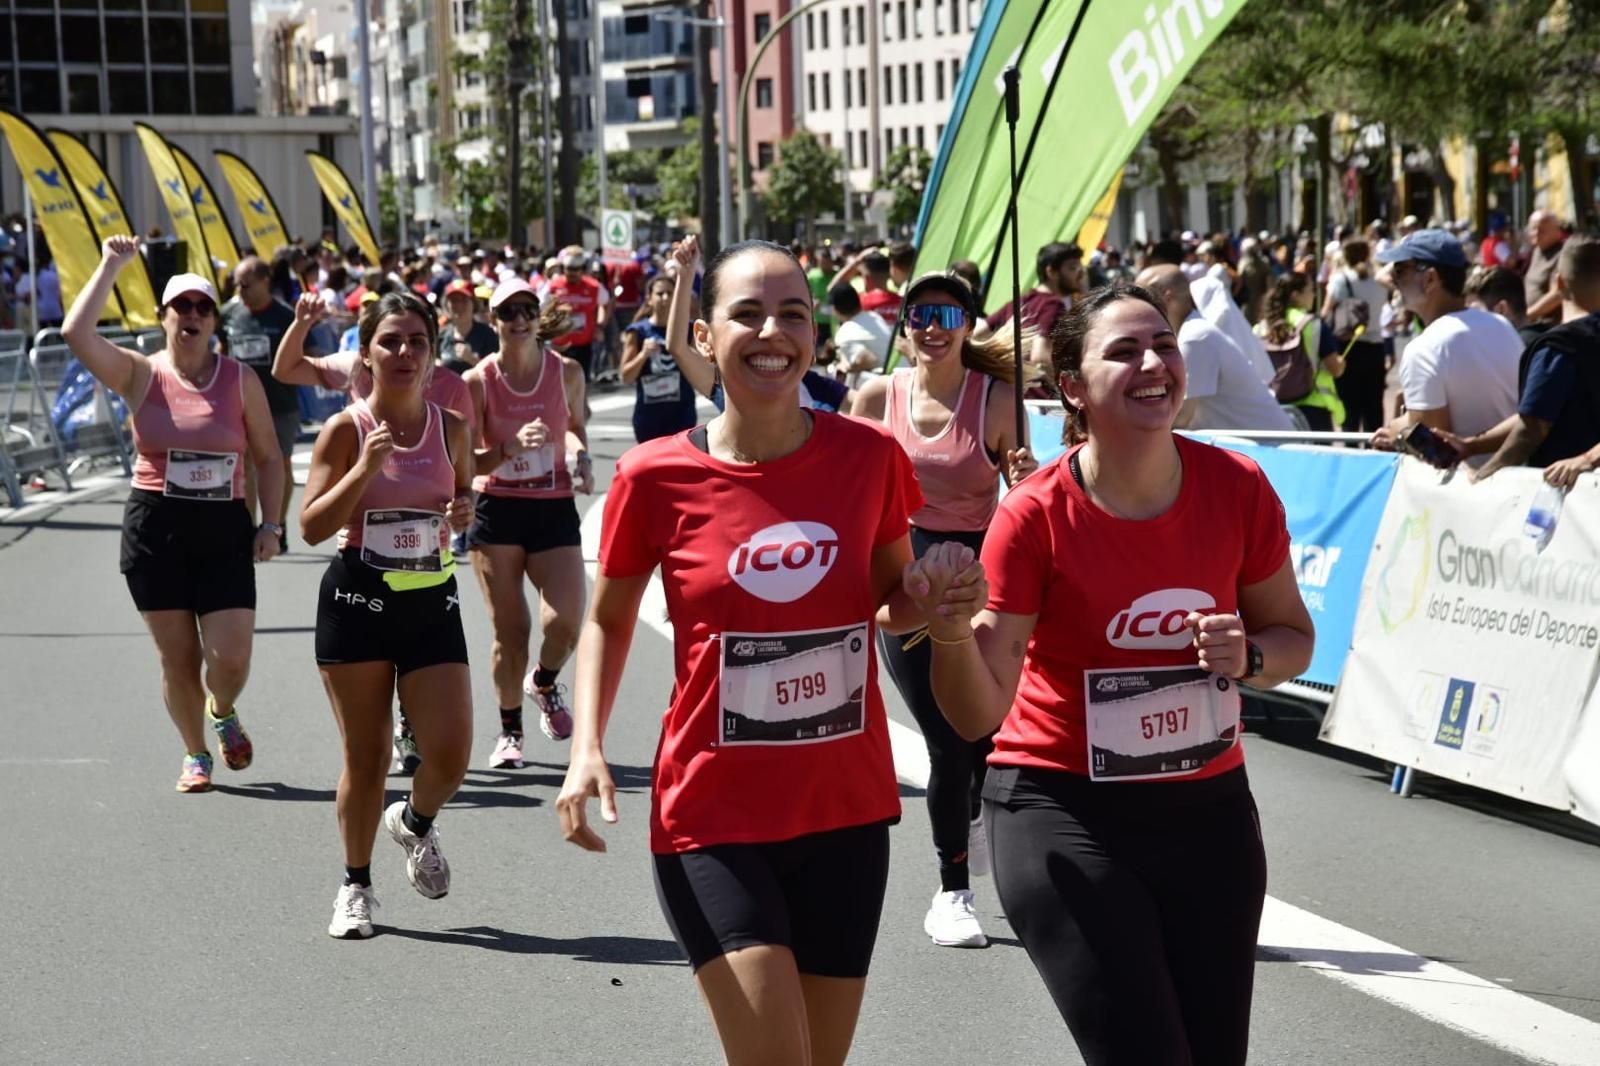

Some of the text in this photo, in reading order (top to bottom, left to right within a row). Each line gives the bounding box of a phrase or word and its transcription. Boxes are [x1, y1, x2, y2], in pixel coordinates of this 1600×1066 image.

[393, 532, 422, 549] 3399
[735, 540, 839, 575] ICOT
[1437, 528, 1496, 590] Gran
[334, 587, 385, 613] HPS
[1426, 593, 1599, 649] Isla Europea del Deporte
[776, 671, 826, 705] 5799
[726, 717, 737, 730] 11
[1140, 706, 1190, 740] 5797
[1095, 753, 1106, 767] 11
